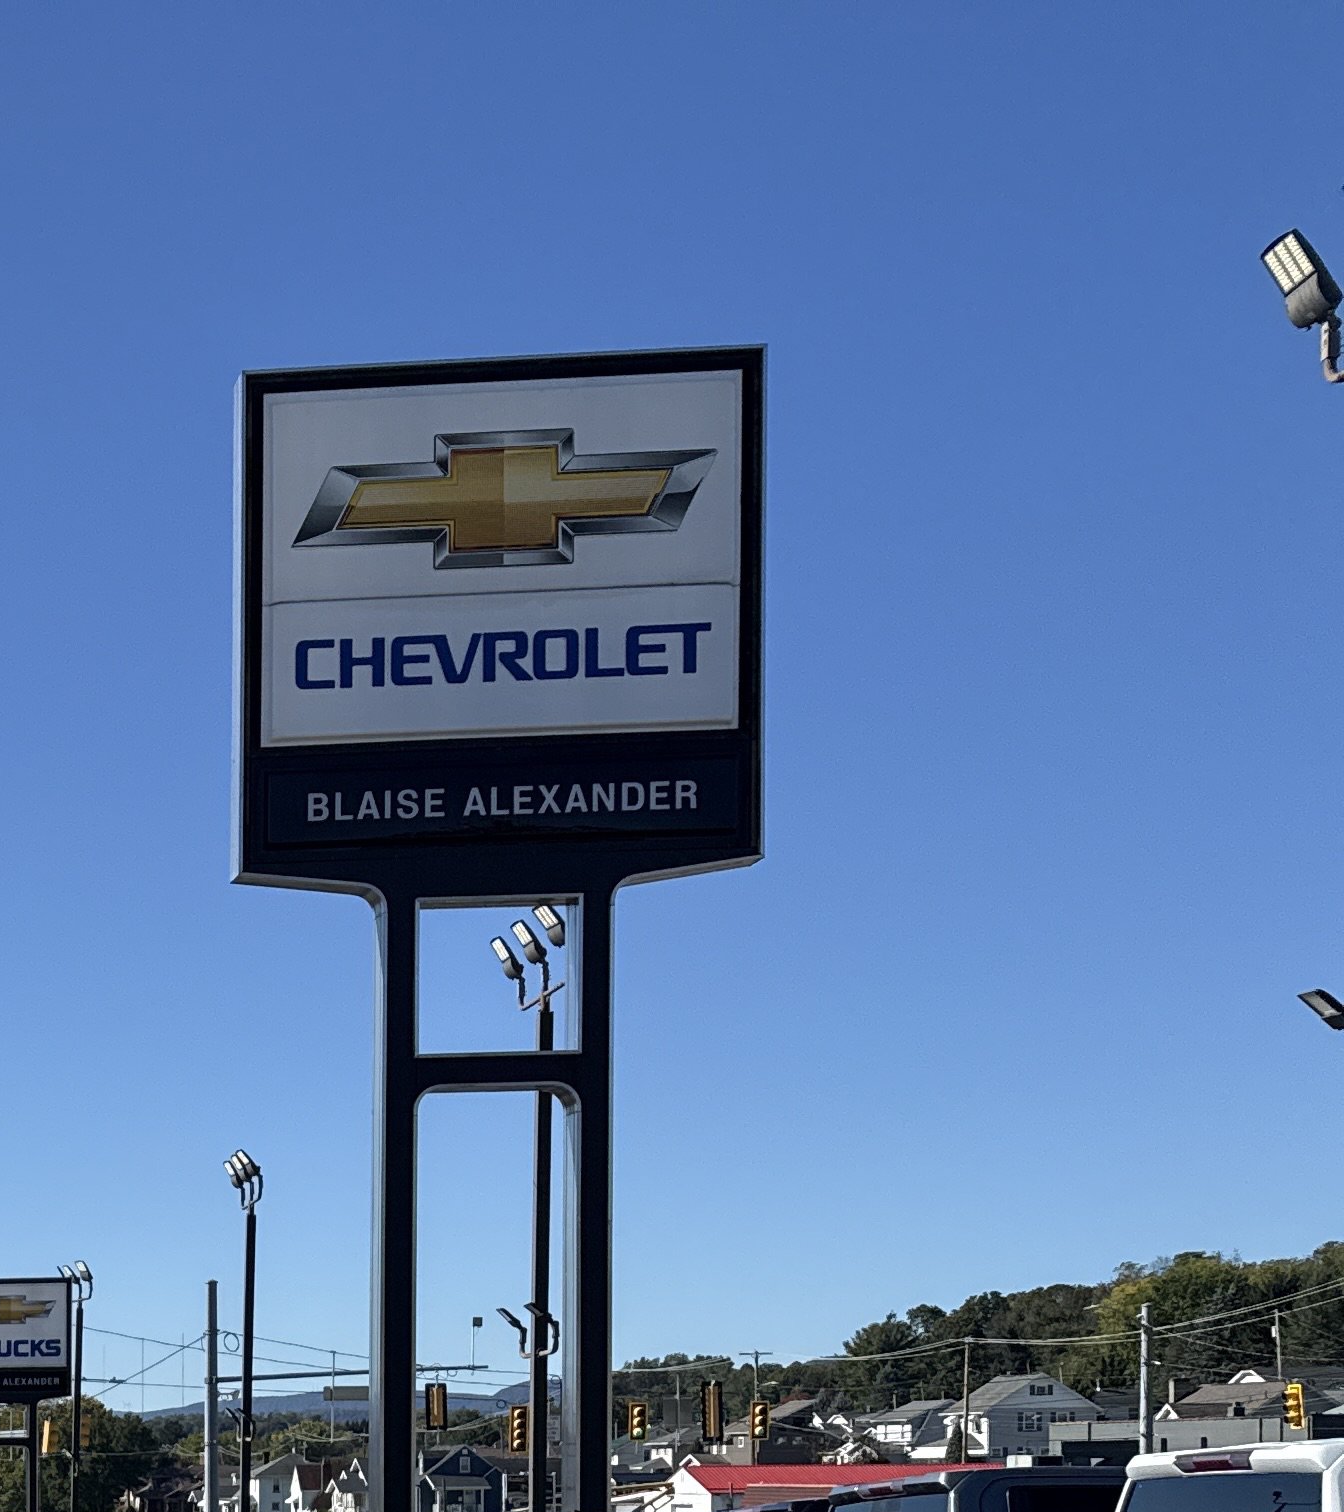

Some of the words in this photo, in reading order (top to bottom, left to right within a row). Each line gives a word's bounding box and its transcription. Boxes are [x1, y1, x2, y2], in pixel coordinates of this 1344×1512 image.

[294, 622, 713, 690] CHEVROLET
[306, 788, 446, 823] BLAISE
[463, 779, 699, 818] ALEXANDER
[2, 1377, 60, 1386] ALEXANDER
